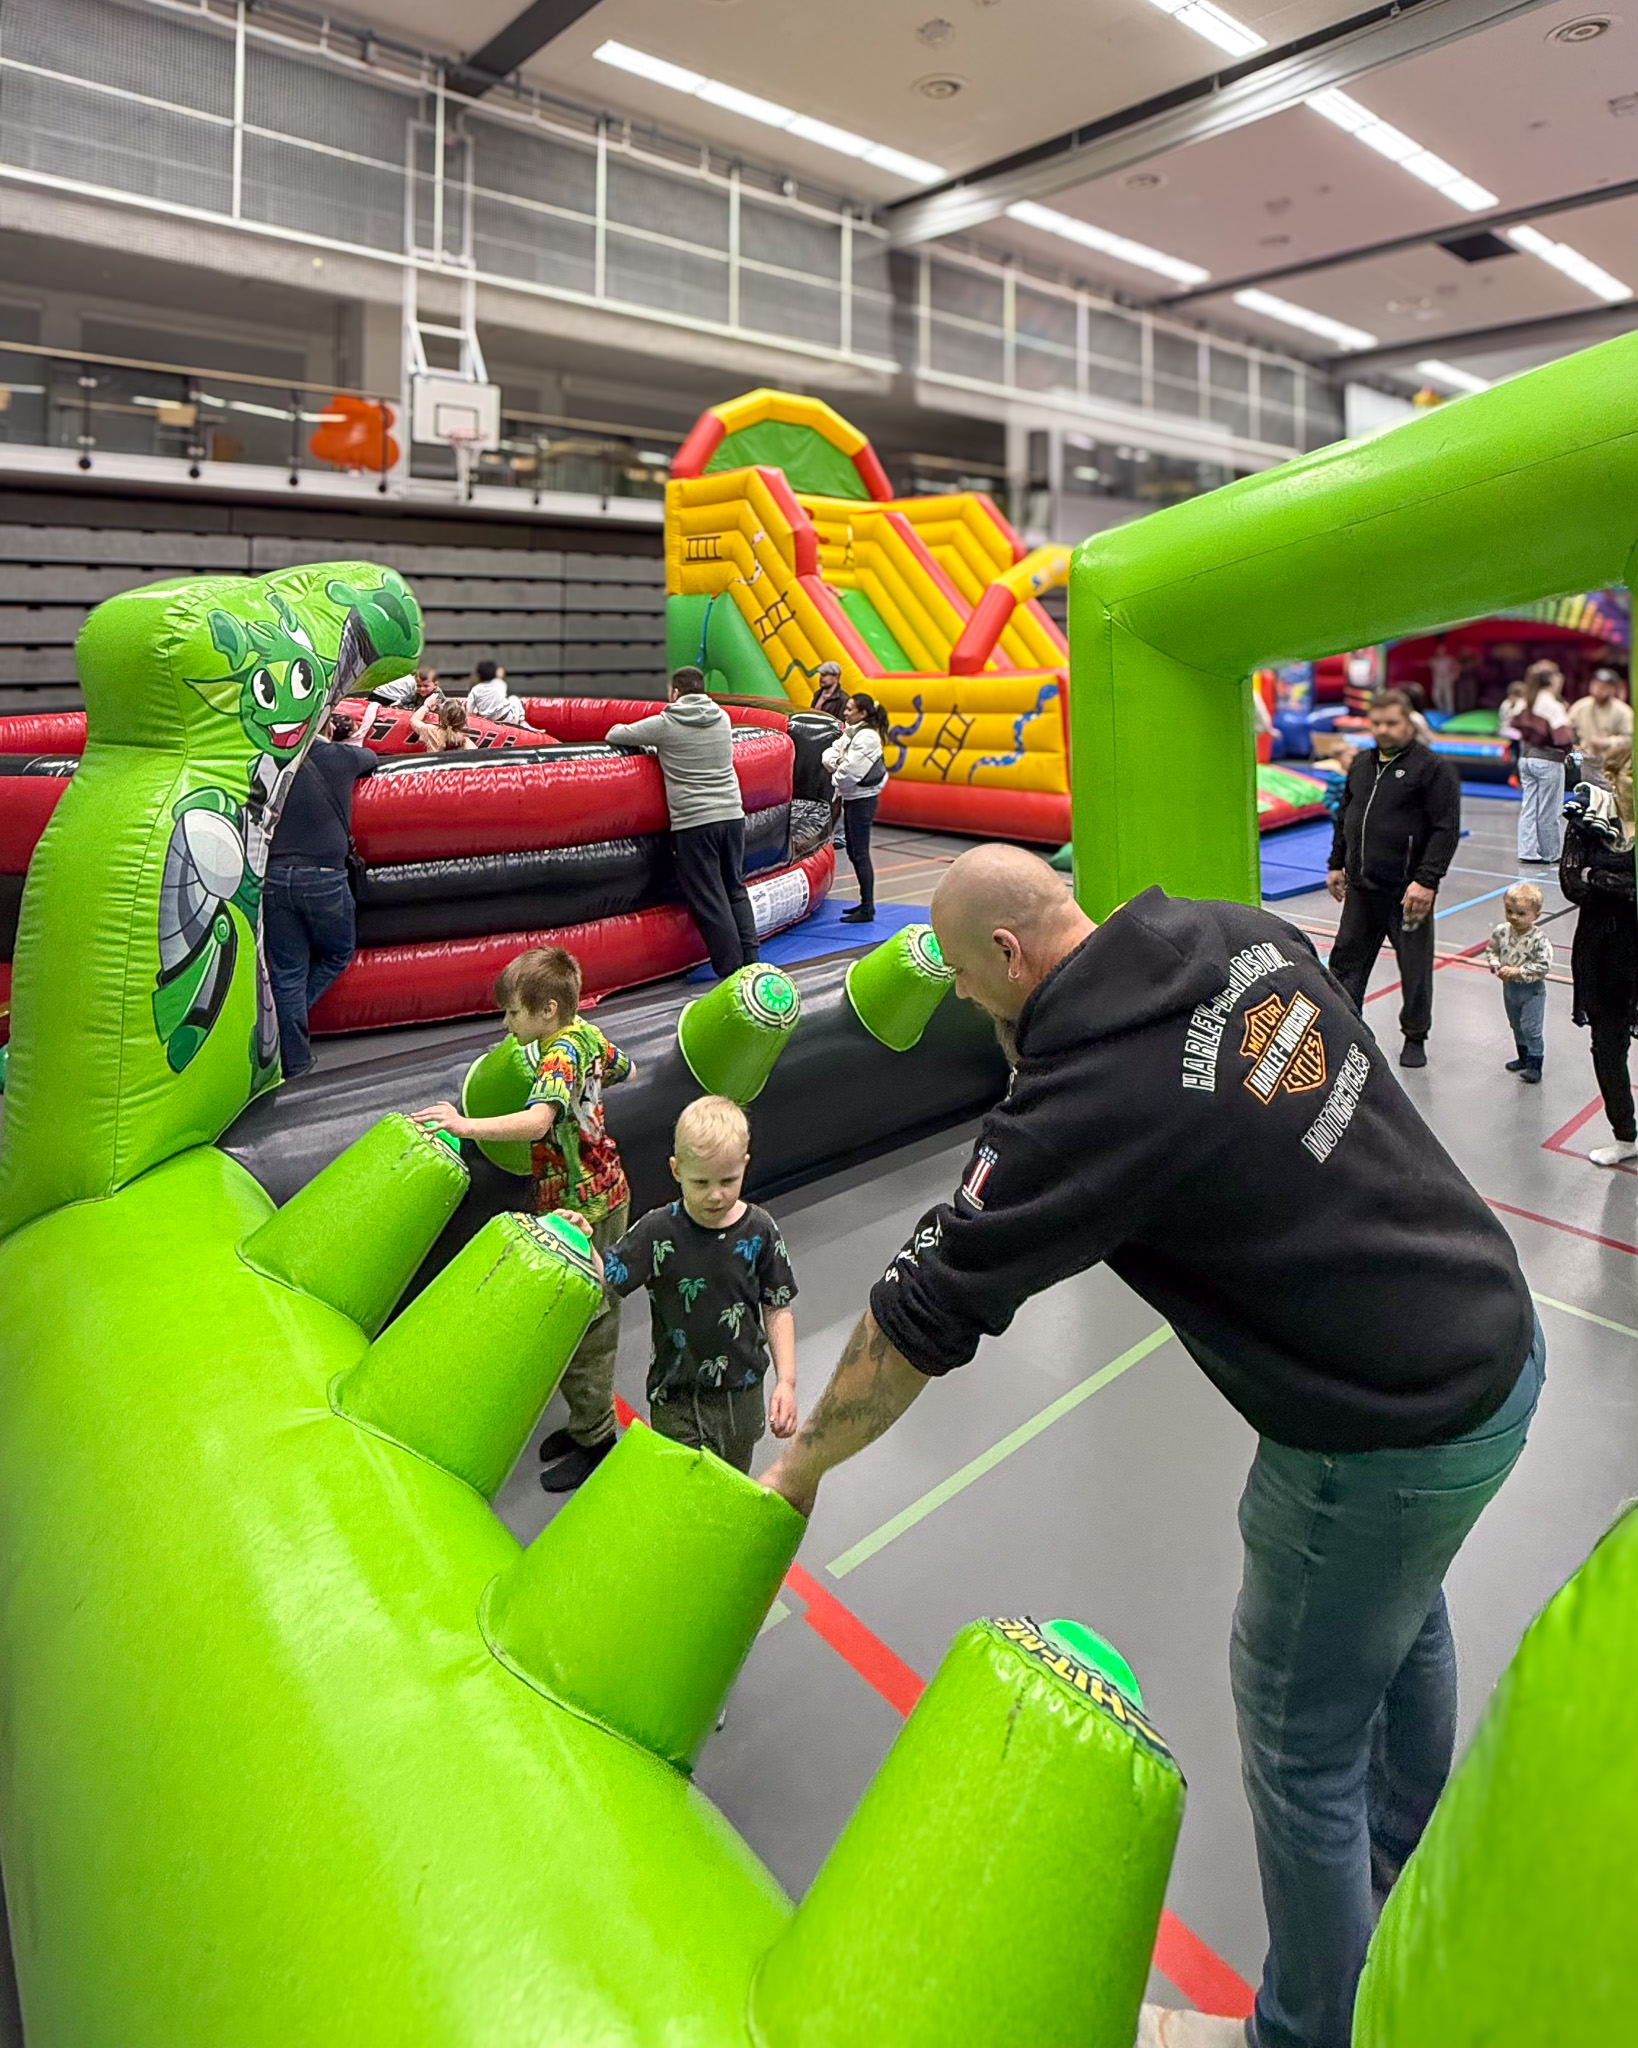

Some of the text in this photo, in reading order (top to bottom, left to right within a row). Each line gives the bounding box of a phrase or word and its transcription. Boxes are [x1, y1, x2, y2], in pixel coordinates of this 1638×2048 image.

[1248, 1003, 1282, 1054] MOTOR
[1249, 997, 1316, 1097] HARLEY-DAVIDSON
[1287, 1035, 1322, 1087] CYCLES
[1301, 1043, 1371, 1163] MOTORCYCLES
